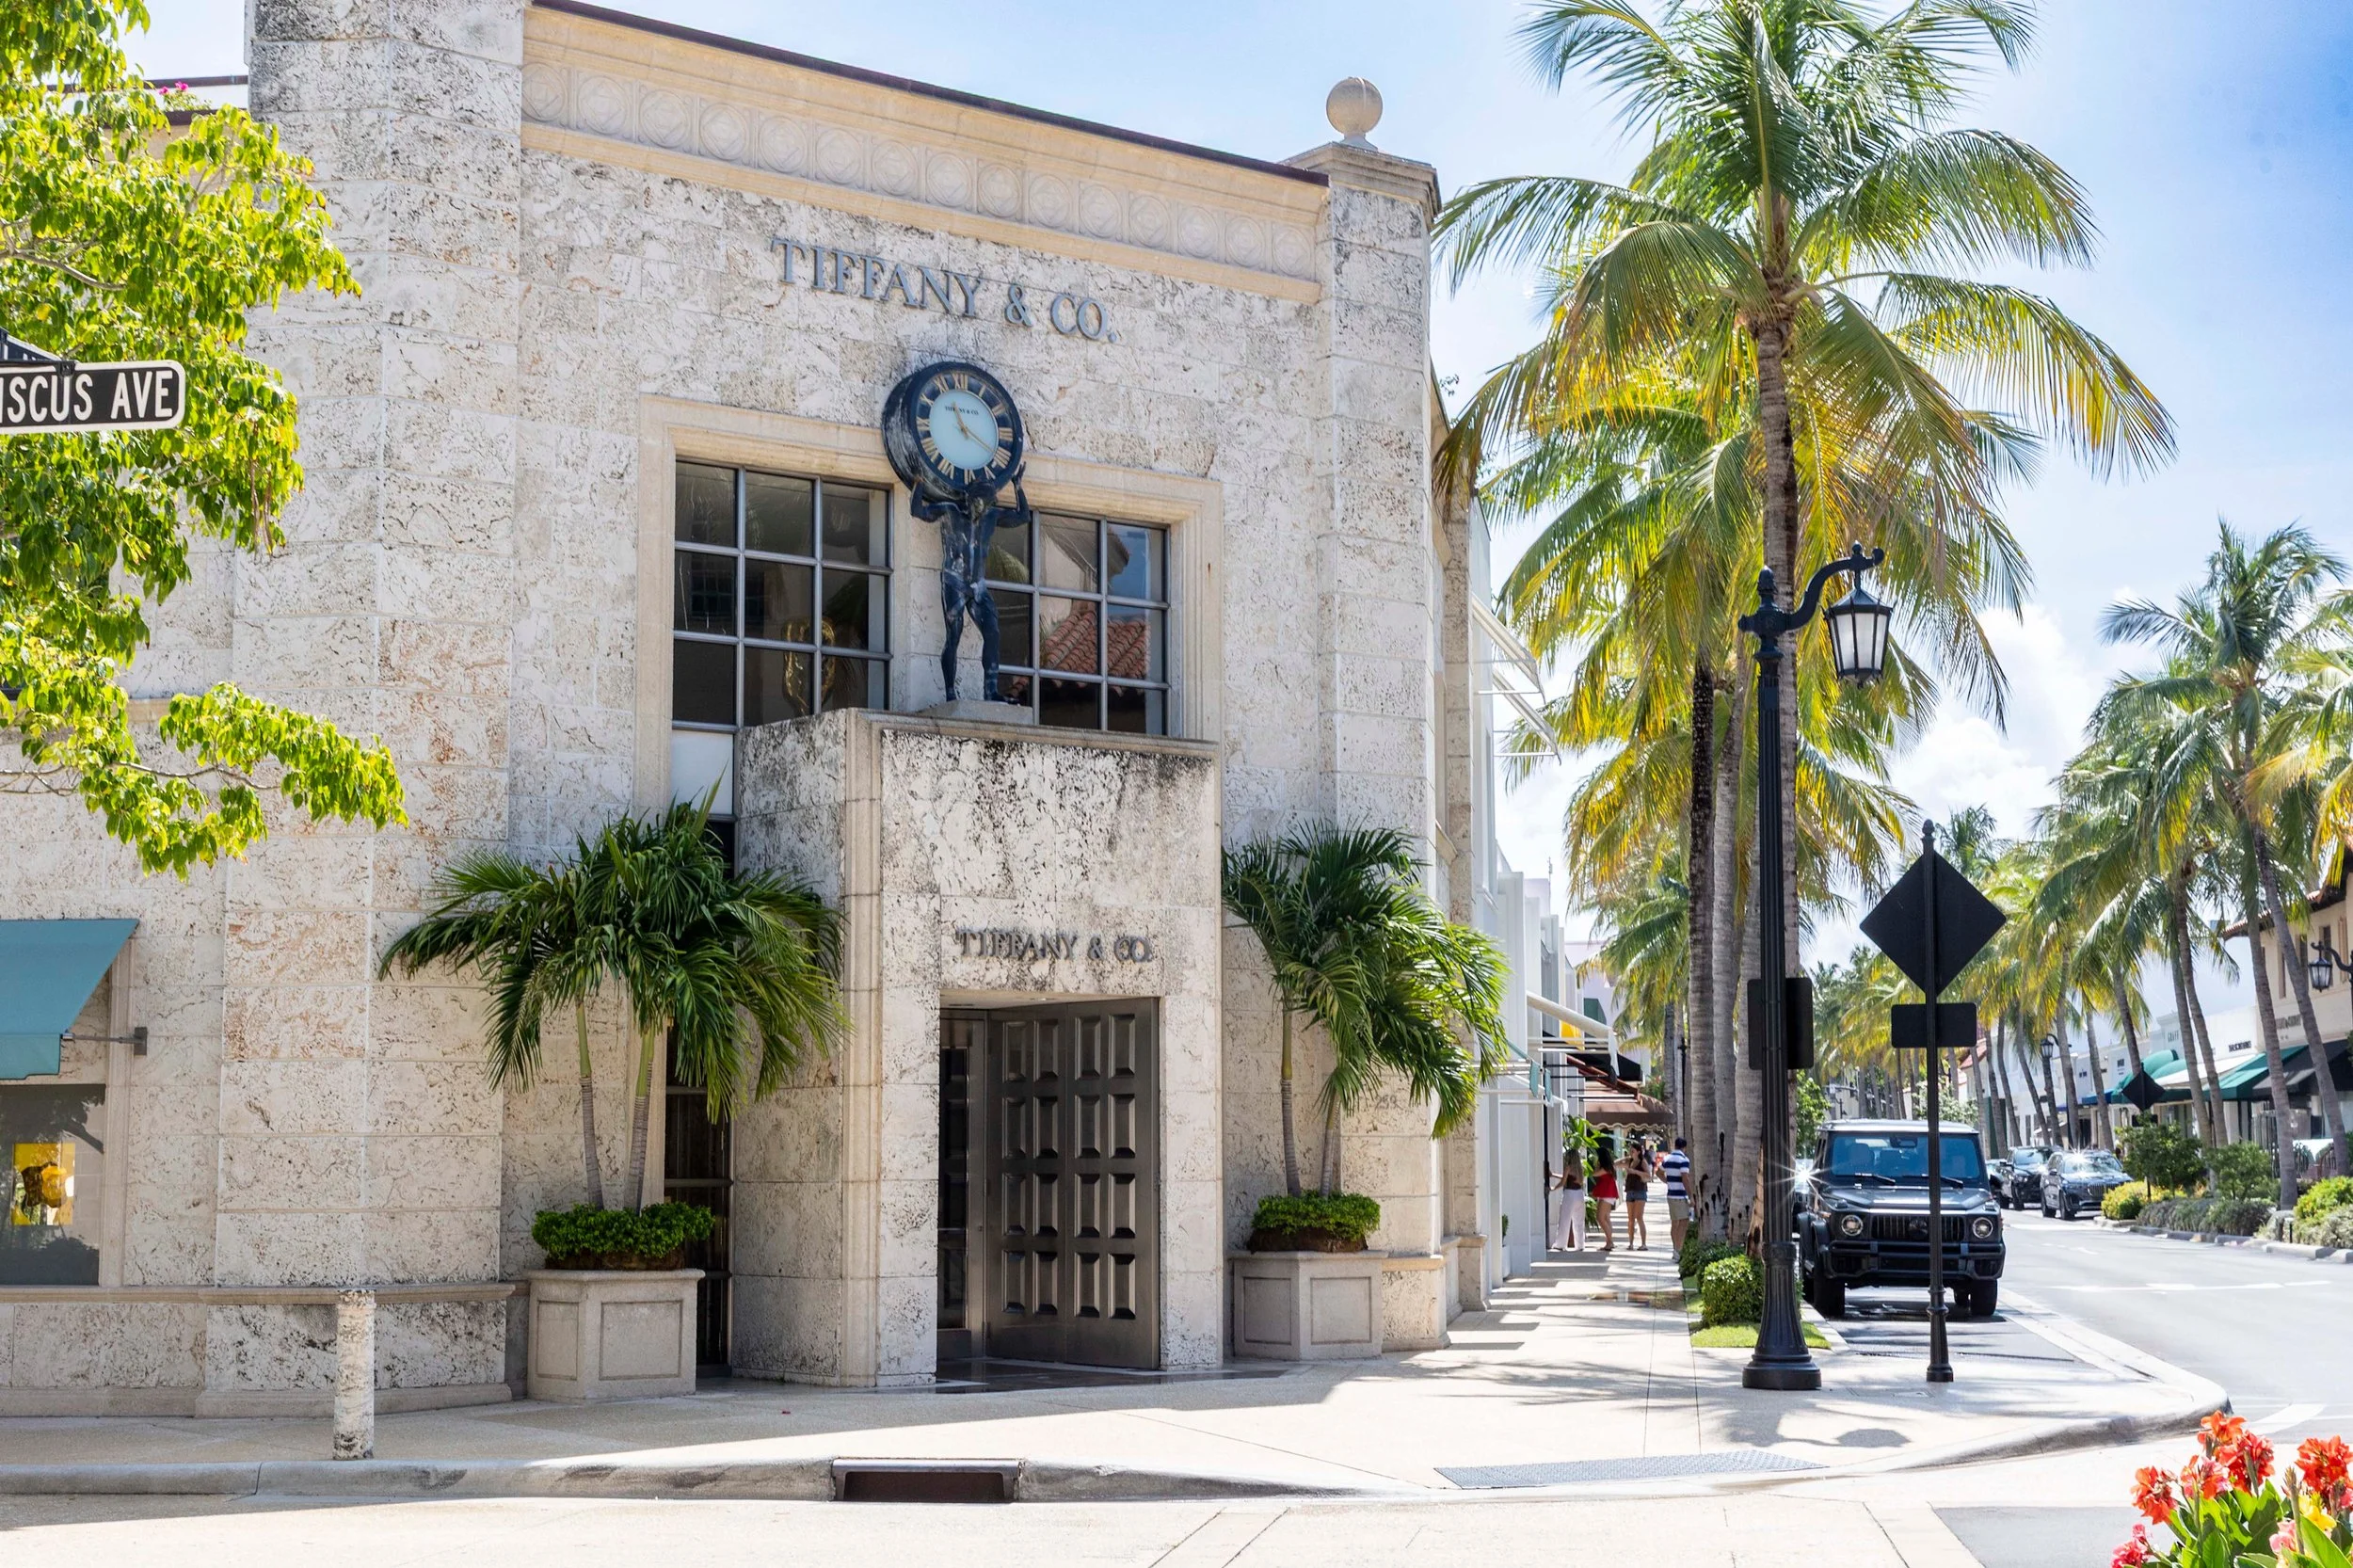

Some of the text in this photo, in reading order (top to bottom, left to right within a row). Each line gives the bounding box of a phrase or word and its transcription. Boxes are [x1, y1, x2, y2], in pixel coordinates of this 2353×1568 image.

[771, 238, 1118, 344] TIFFANY & CO.
[110, 370, 173, 420] AVE
[956, 926, 1079, 961] TIFFANY
[1087, 935, 1105, 961] &
